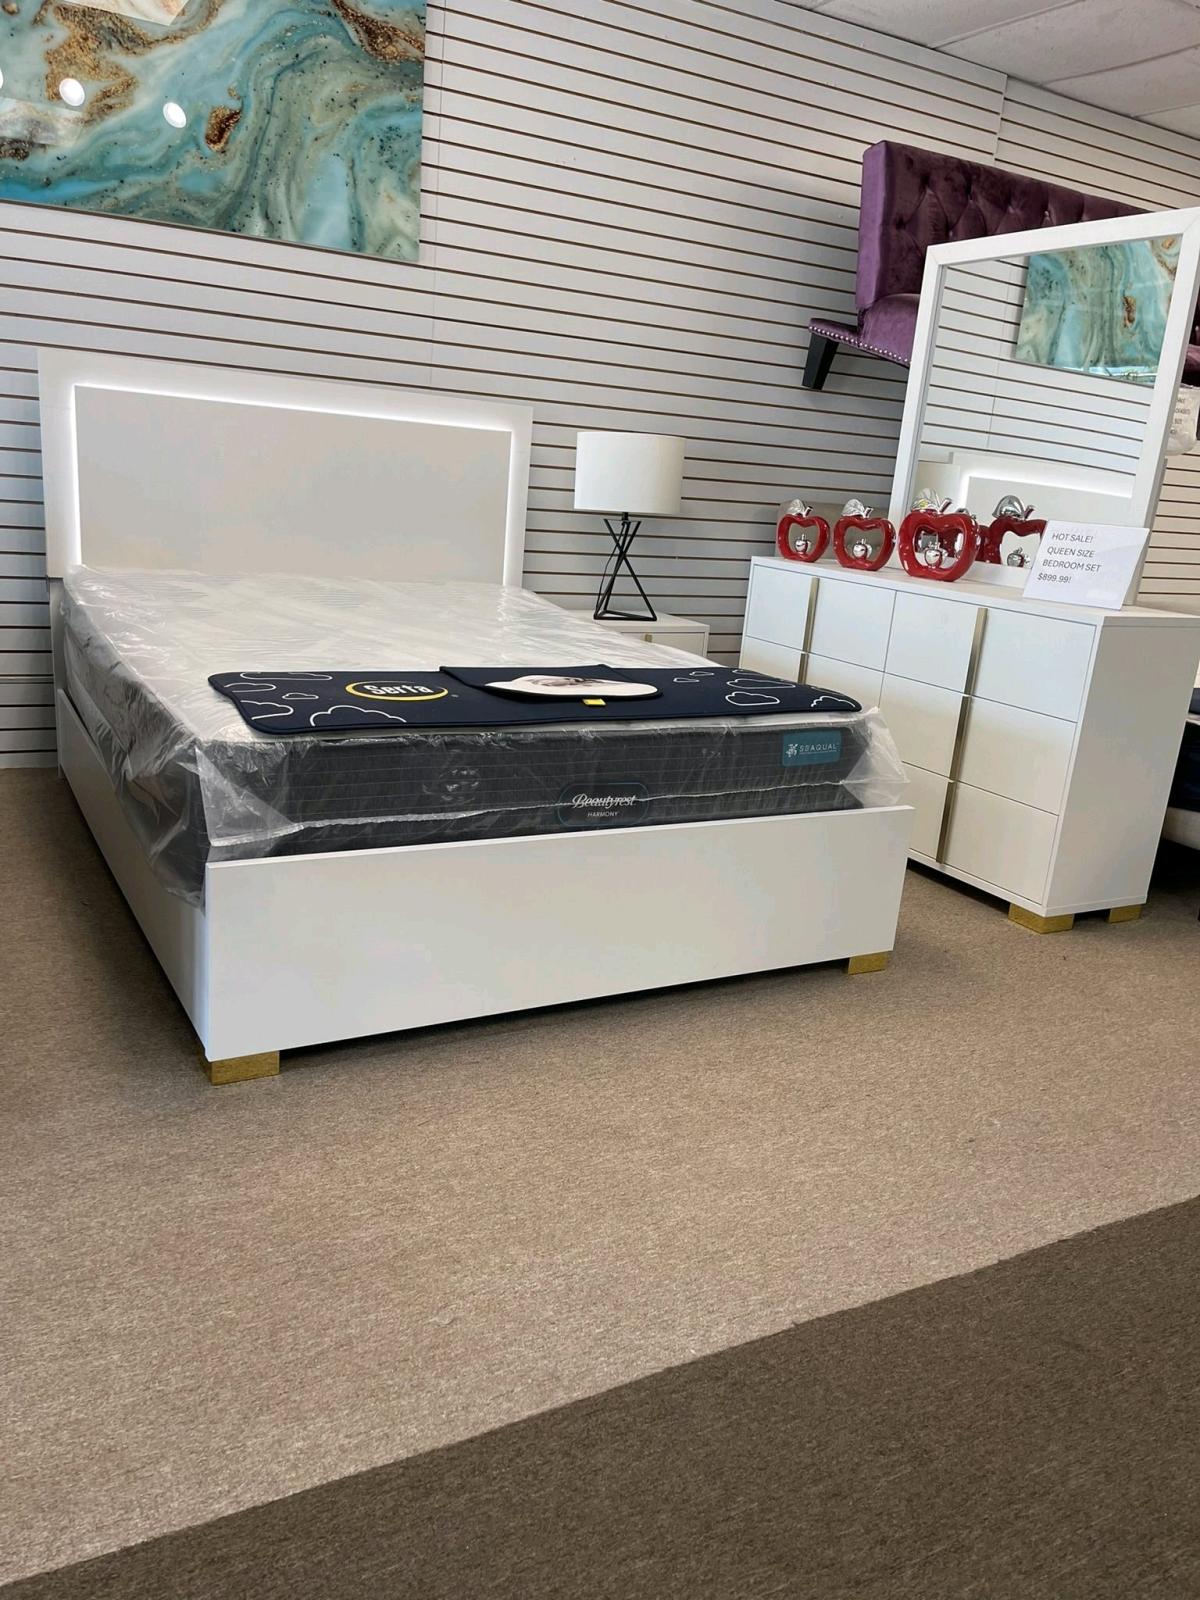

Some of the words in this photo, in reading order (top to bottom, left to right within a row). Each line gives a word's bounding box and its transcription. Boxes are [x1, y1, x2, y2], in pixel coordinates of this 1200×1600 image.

[1052, 533, 1069, 541] HOT
[1070, 535, 1093, 543] SALE!
[1047, 546, 1076, 556] QUEEN
[1077, 549, 1095, 558] SIZE
[1042, 559, 1084, 570] BEDROOM
[1085, 564, 1101, 572] SET
[1037, 572, 1071, 583] $899.99!
[572, 794, 636, 809] Beautyrest
